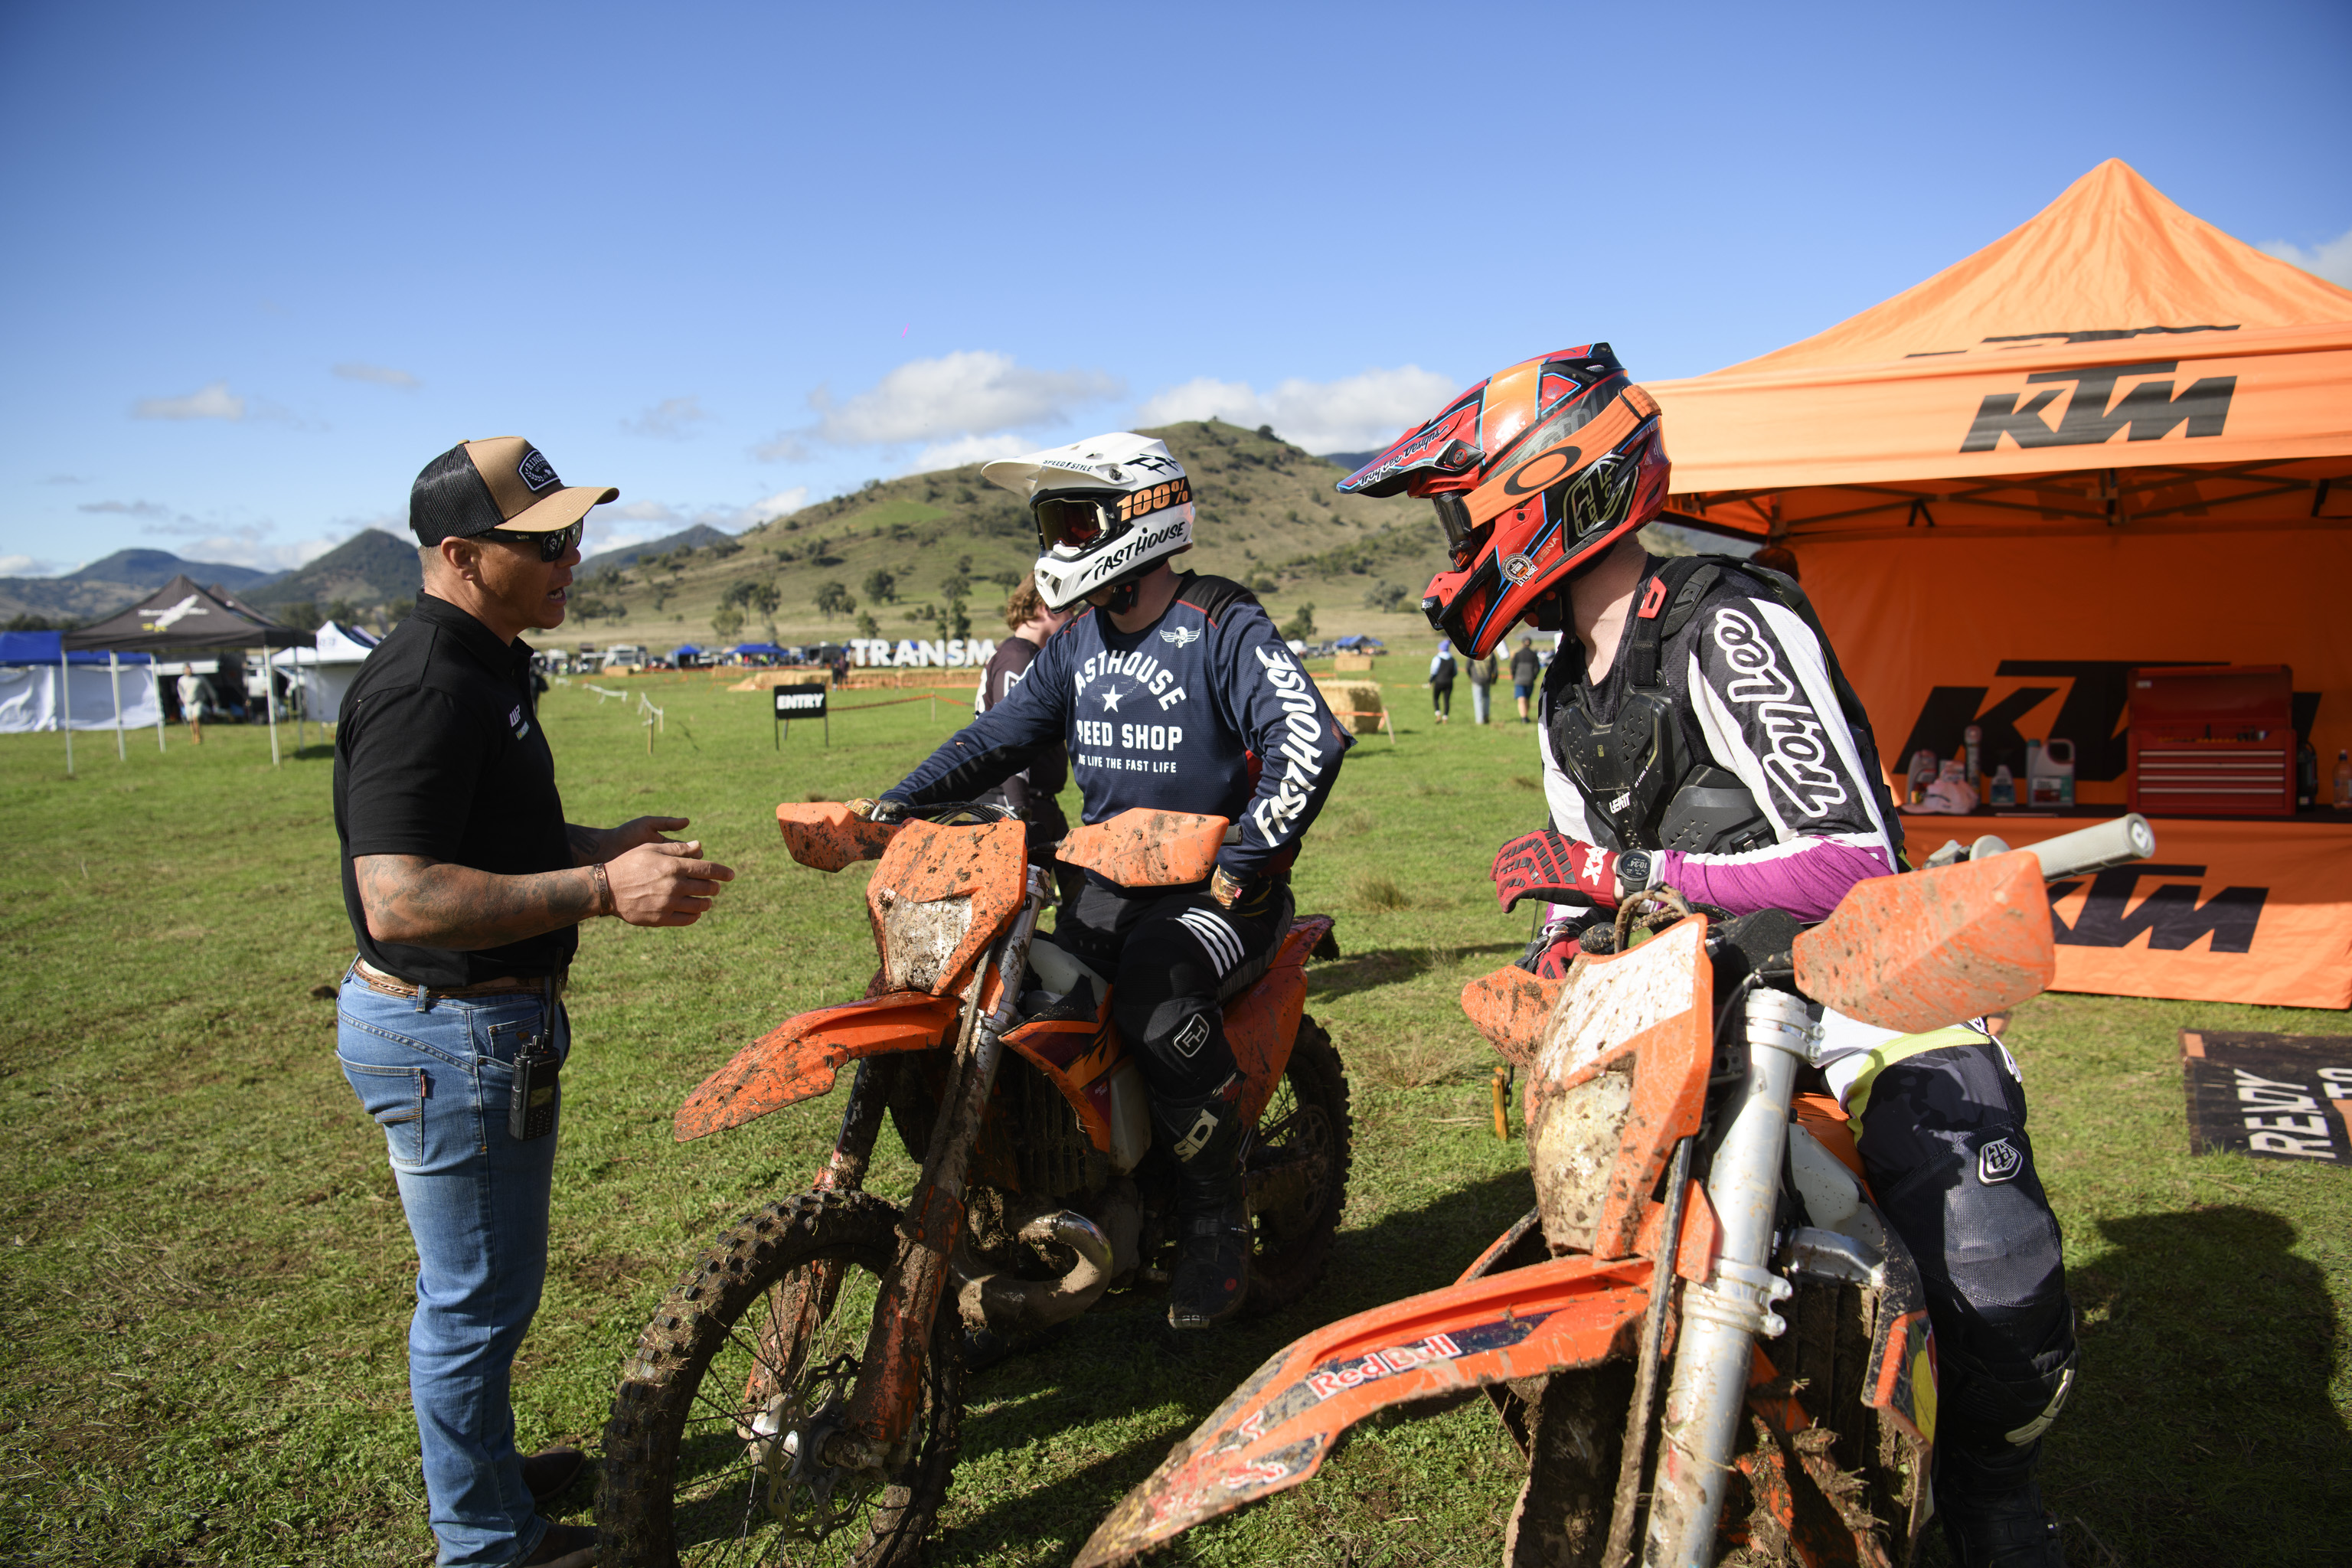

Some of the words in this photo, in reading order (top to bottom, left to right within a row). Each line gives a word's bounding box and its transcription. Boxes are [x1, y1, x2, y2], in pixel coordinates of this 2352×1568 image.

[1959, 361, 2238, 453] KTM
[1403, 425, 1449, 459] Designs
[1070, 462, 1094, 472] STYLE
[1116, 479, 1188, 522] 100%
[1094, 521, 1186, 580] FASTHOUSE
[1534, 537, 1560, 565] SENA
[1074, 649, 1187, 711] ASTHOUSE
[776, 692, 825, 710] ENTRY
[1122, 724, 1183, 751] SHOP
[1892, 660, 2321, 782] KT
[1087, 756, 1102, 768] LIVE
[1106, 757, 1122, 769] THE
[1125, 760, 1149, 772] FAST
[1153, 761, 1177, 773] LIFE
[1253, 645, 1323, 848] FASTHOUSE
[1630, 860, 1648, 869] 10:34
[2233, 1068, 2337, 1159] READY
